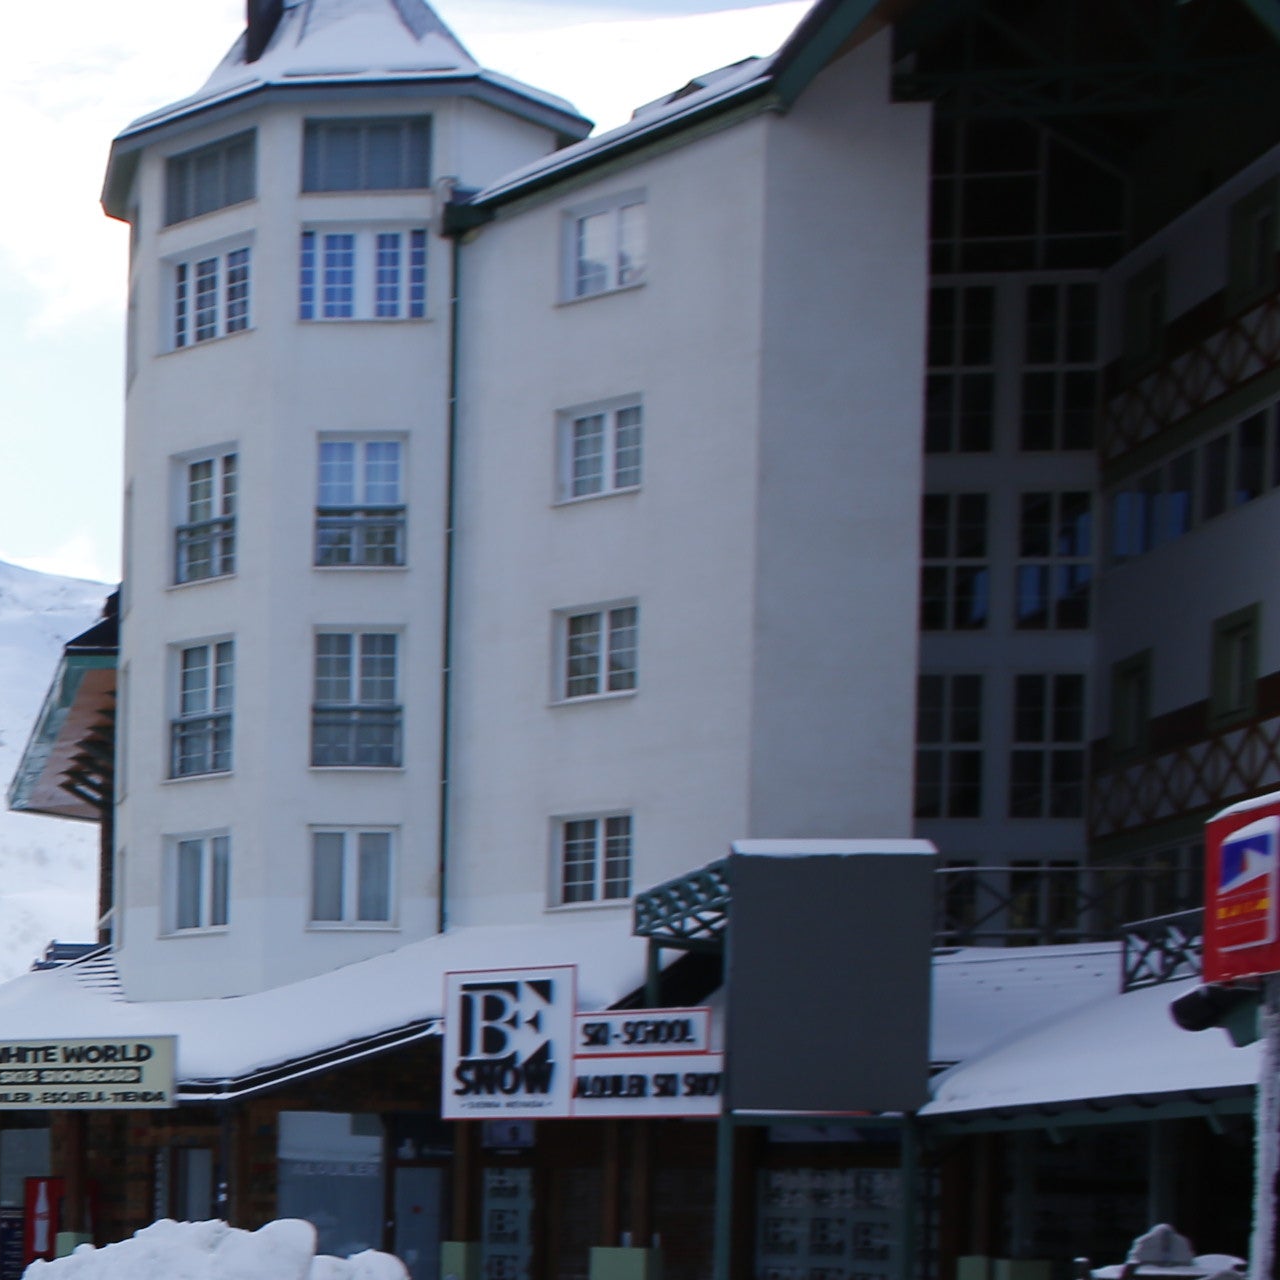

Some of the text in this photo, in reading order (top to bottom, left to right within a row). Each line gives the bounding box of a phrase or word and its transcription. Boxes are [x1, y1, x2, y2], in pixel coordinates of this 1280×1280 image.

[460, 979, 553, 1064] BE
[582, 1022, 609, 1045] SKI
[622, 1019, 695, 1045] SCHOOL
[62, 1043, 153, 1064] WORLD
[40, 1068, 140, 1083] SNOWBOARD
[454, 1060, 555, 1095] SNOW
[574, 1075, 647, 1098] ALQUILER
[652, 1073, 678, 1097] SKI
